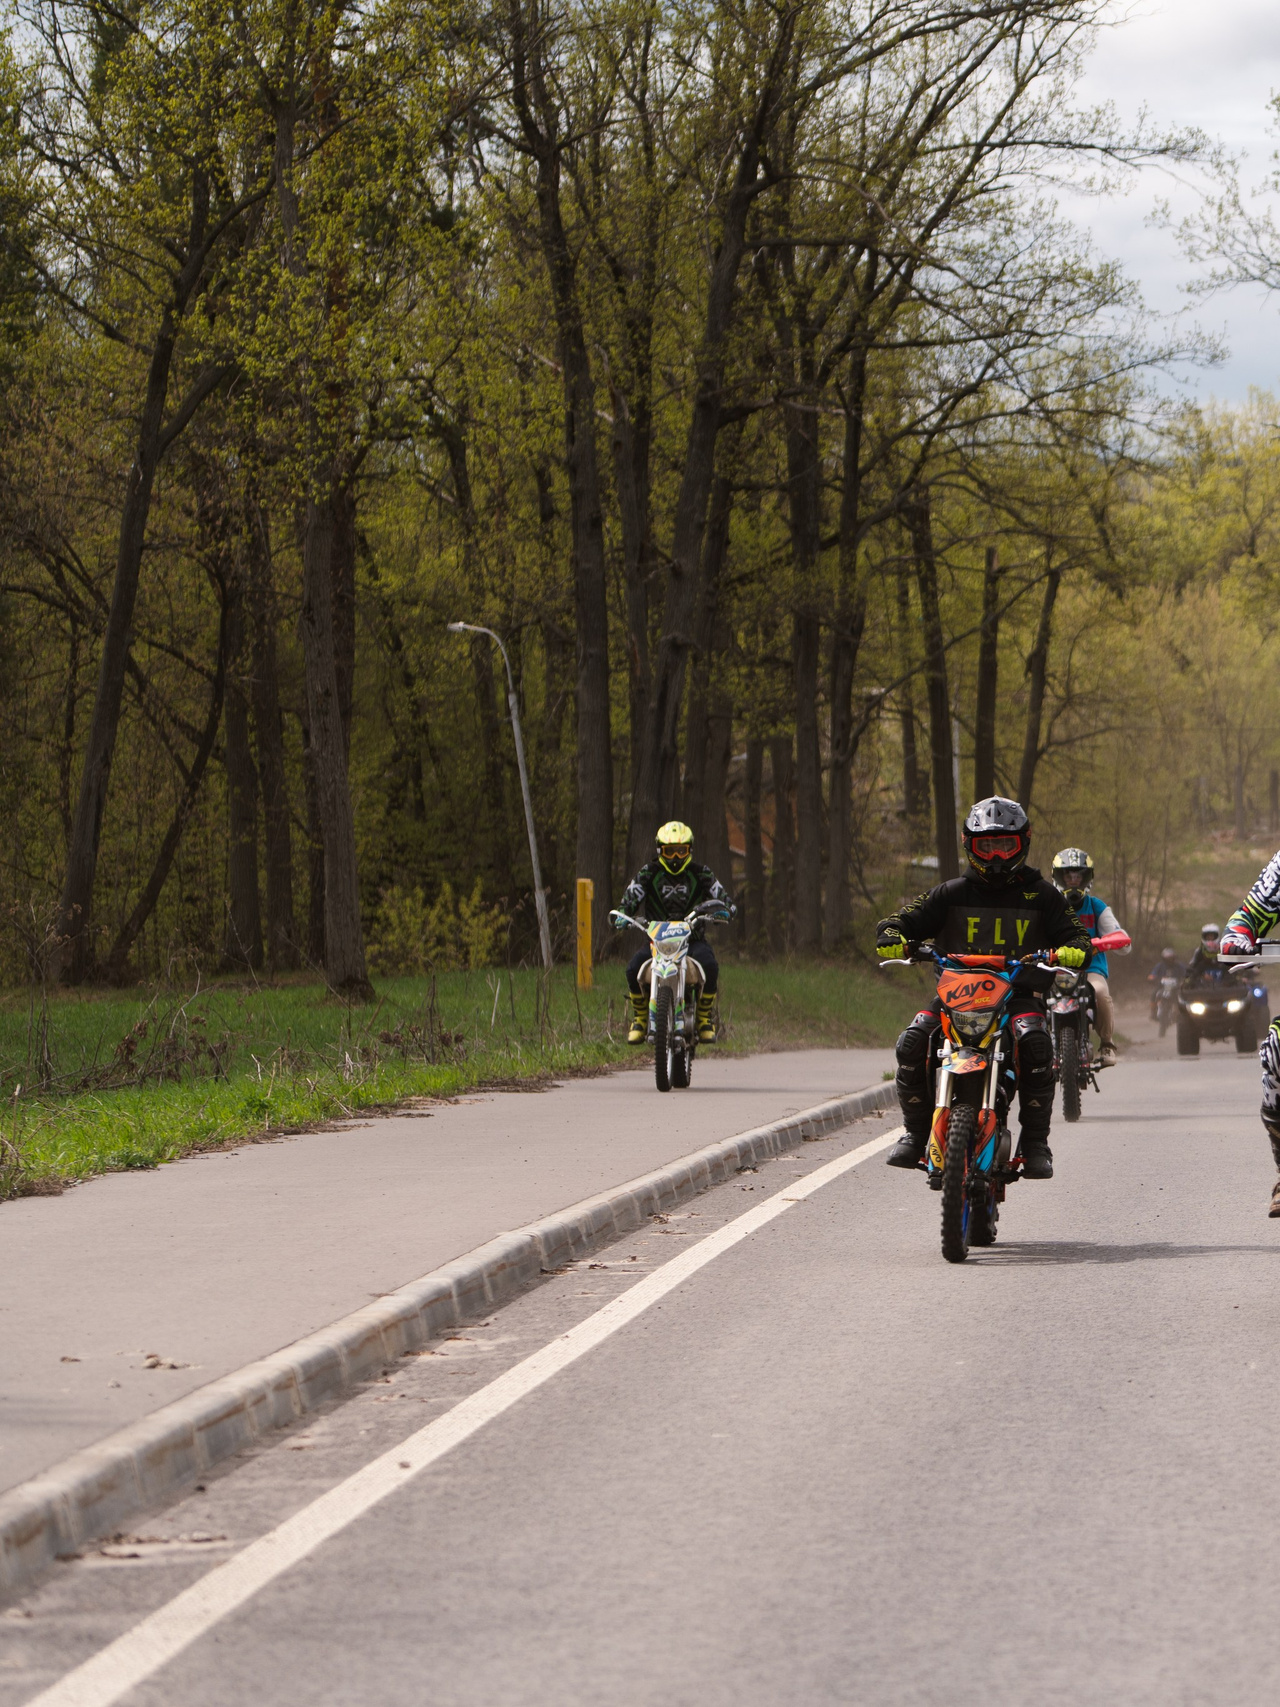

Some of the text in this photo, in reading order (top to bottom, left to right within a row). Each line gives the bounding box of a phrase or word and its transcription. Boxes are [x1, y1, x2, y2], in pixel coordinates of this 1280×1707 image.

[661, 928, 683, 938] KAYO
[967, 916, 1031, 946] FLY
[945, 979, 996, 1003] KAYO
